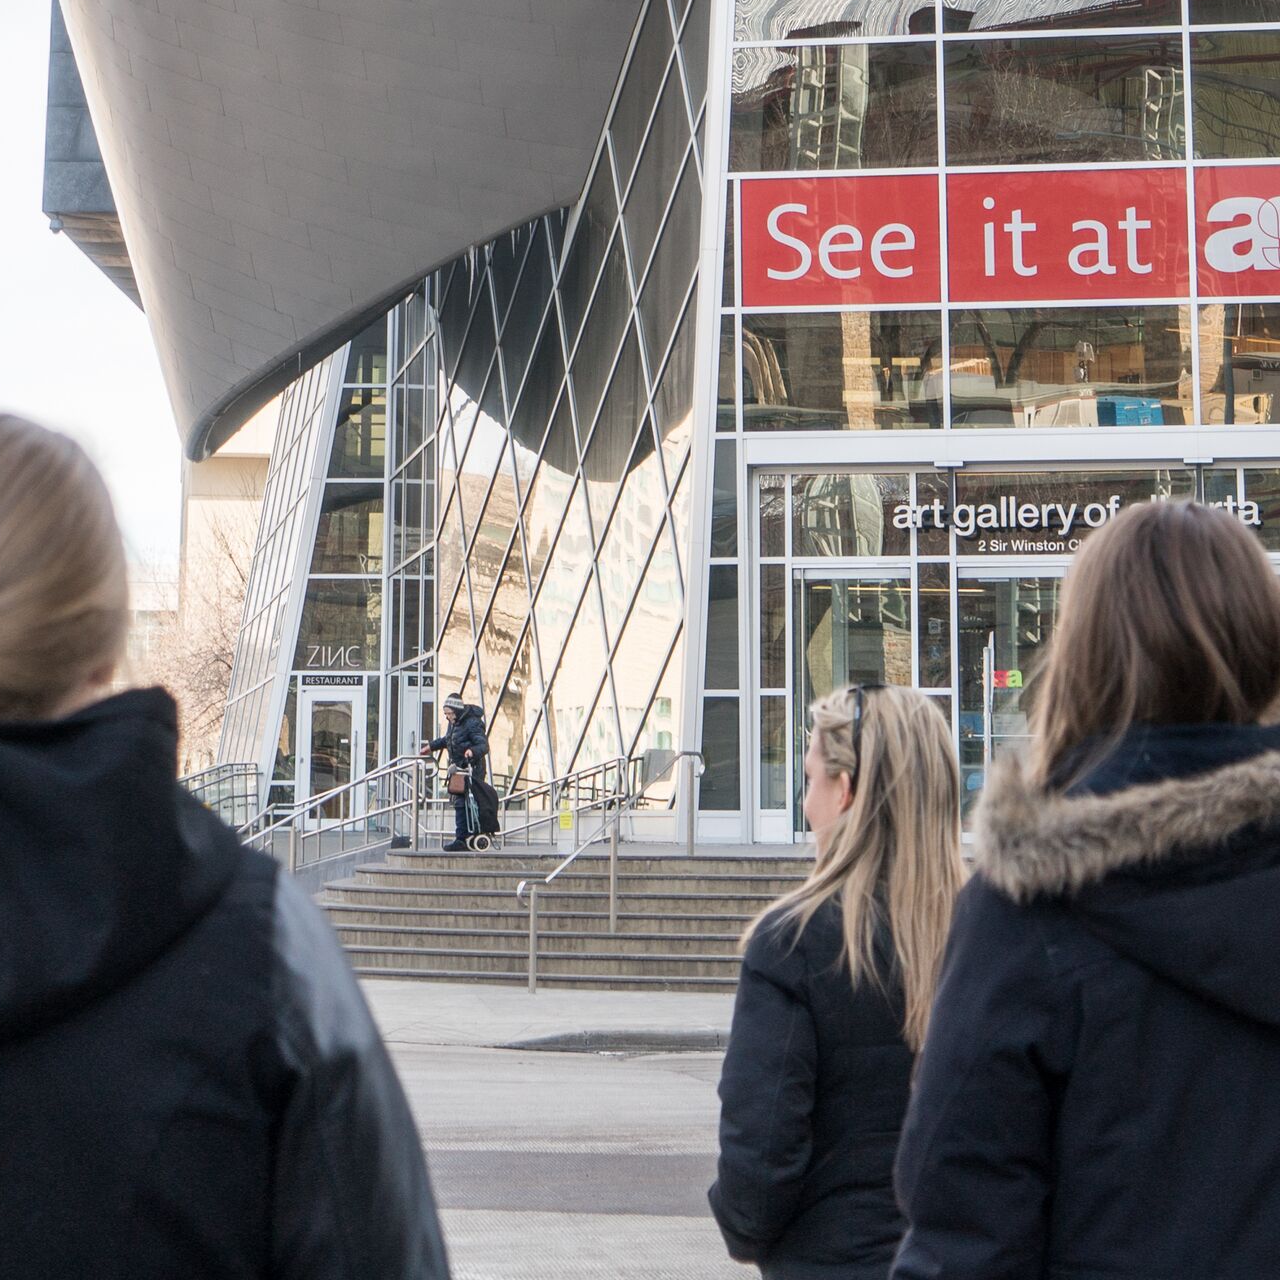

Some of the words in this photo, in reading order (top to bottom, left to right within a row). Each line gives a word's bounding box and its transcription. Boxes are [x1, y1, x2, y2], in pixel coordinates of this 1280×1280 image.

[766, 202, 916, 281] See
[982, 196, 1038, 277] it
[1067, 206, 1153, 276] at
[892, 498, 946, 529] art
[952, 496, 1077, 537] gallery
[1083, 495, 1120, 528] of
[977, 539, 987, 552] 2
[989, 539, 1009, 552] Sir
[1012, 539, 1065, 552] Winston
[306, 645, 361, 668] ZINC
[305, 676, 360, 685] RESTAURANT
